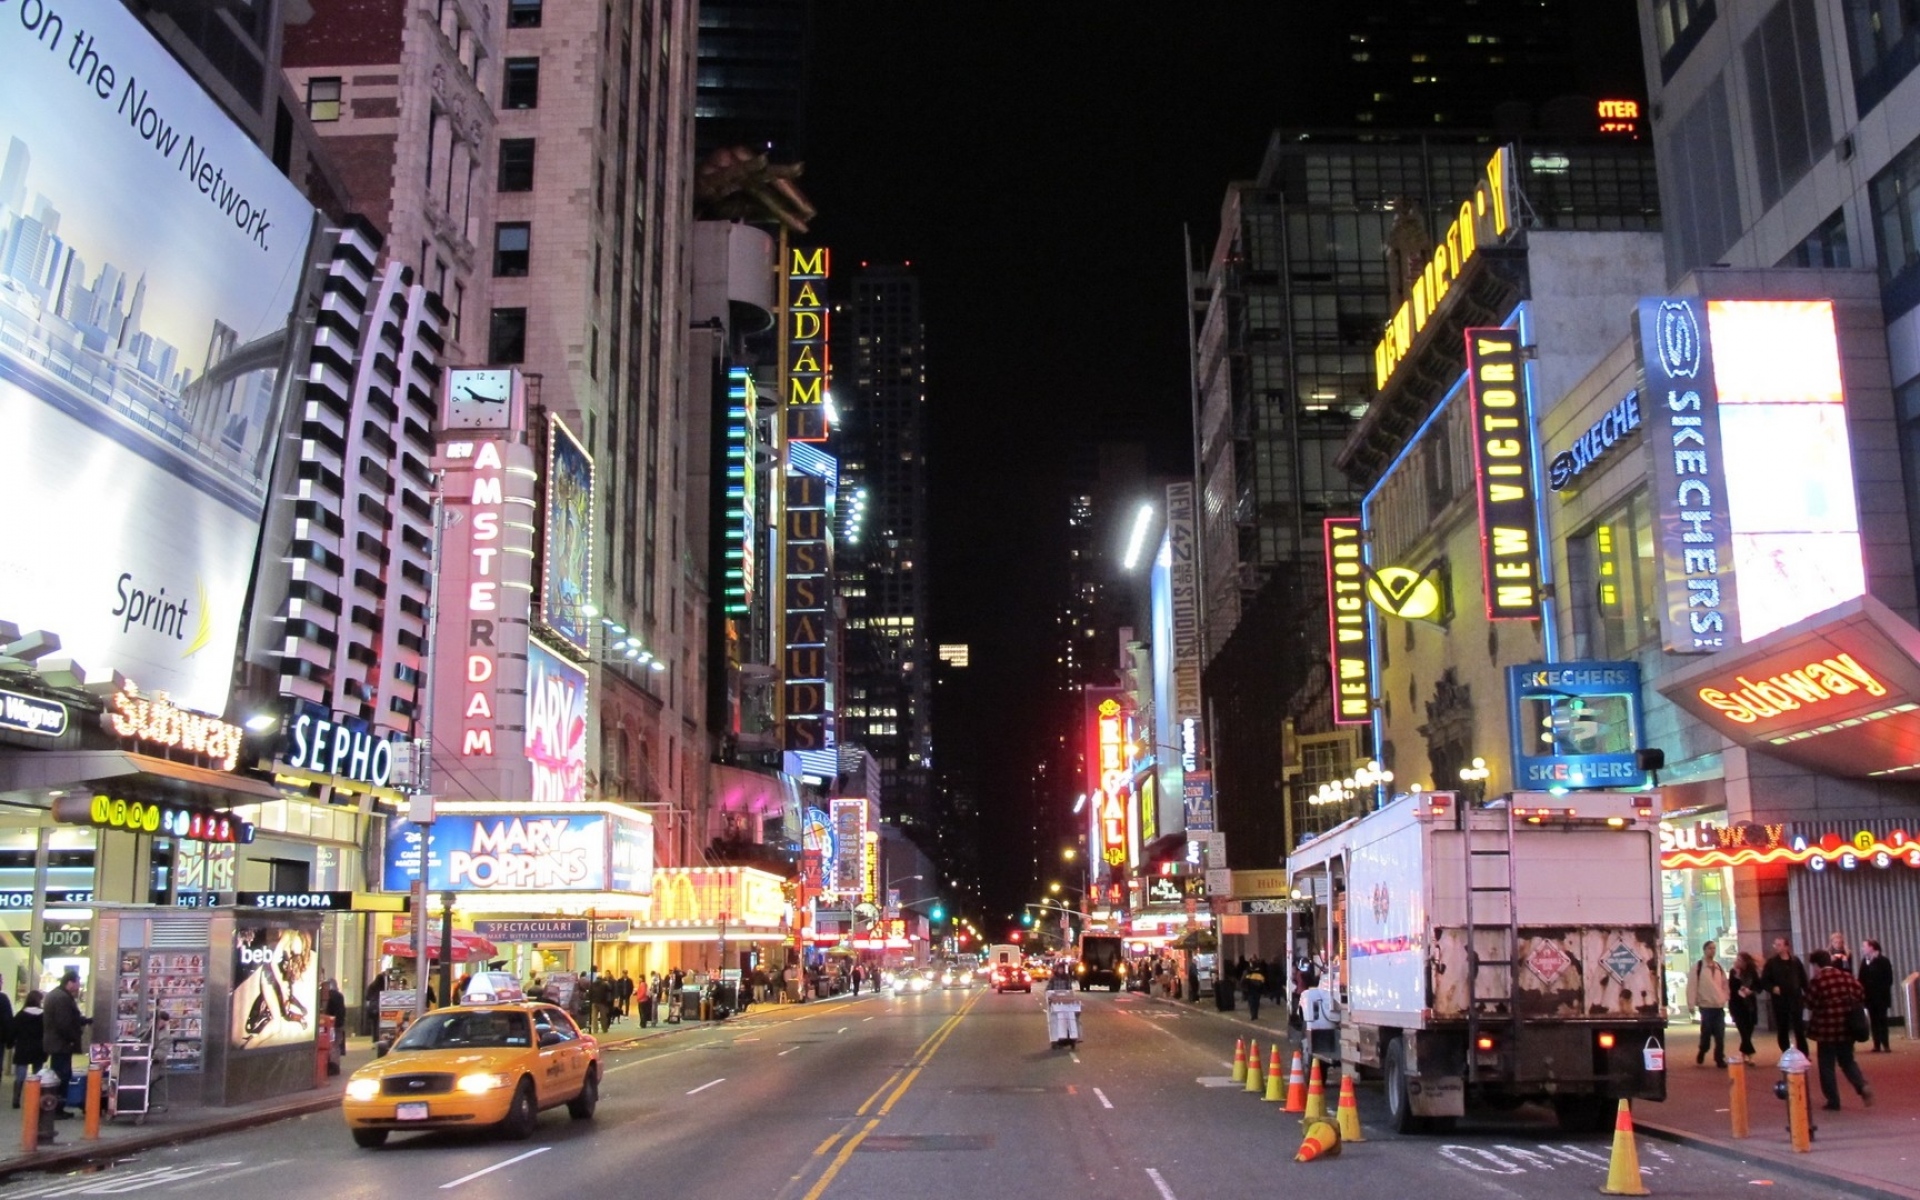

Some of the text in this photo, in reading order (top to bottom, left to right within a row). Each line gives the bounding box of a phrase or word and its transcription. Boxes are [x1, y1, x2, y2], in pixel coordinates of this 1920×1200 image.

[20, 0, 270, 251] on the Now Network.
[476, 372, 486, 380] 12
[1571, 389, 1641, 475] SKECHE
[1169, 485, 1191, 520] NEW
[1478, 339, 1533, 607] VICTORY NEW
[1171, 524, 1192, 561] 42
[1668, 390, 1724, 634] SKECHERS
[112, 572, 188, 640] Sprint
[462, 441, 503, 757] AMSTERDAM
[1174, 586, 1197, 658] STUDIOS
[1333, 527, 1367, 715] VICTORY NEW
[1522, 670, 1629, 688] SKECHERS
[1699, 653, 1887, 723] Subway
[112, 679, 243, 771] Subway
[291, 714, 392, 787] SEPHO
[1101, 719, 1123, 844] REGAL
[1529, 762, 1635, 781] SKECHERS
[449, 849, 587, 887] POPPINS
[472, 819, 569, 853] MARY
[0, 894, 33, 907] HOR
[257, 895, 331, 907] SEPHORA
[1257, 879, 1287, 889] Hilto
[22, 931, 82, 946] SUDIO
